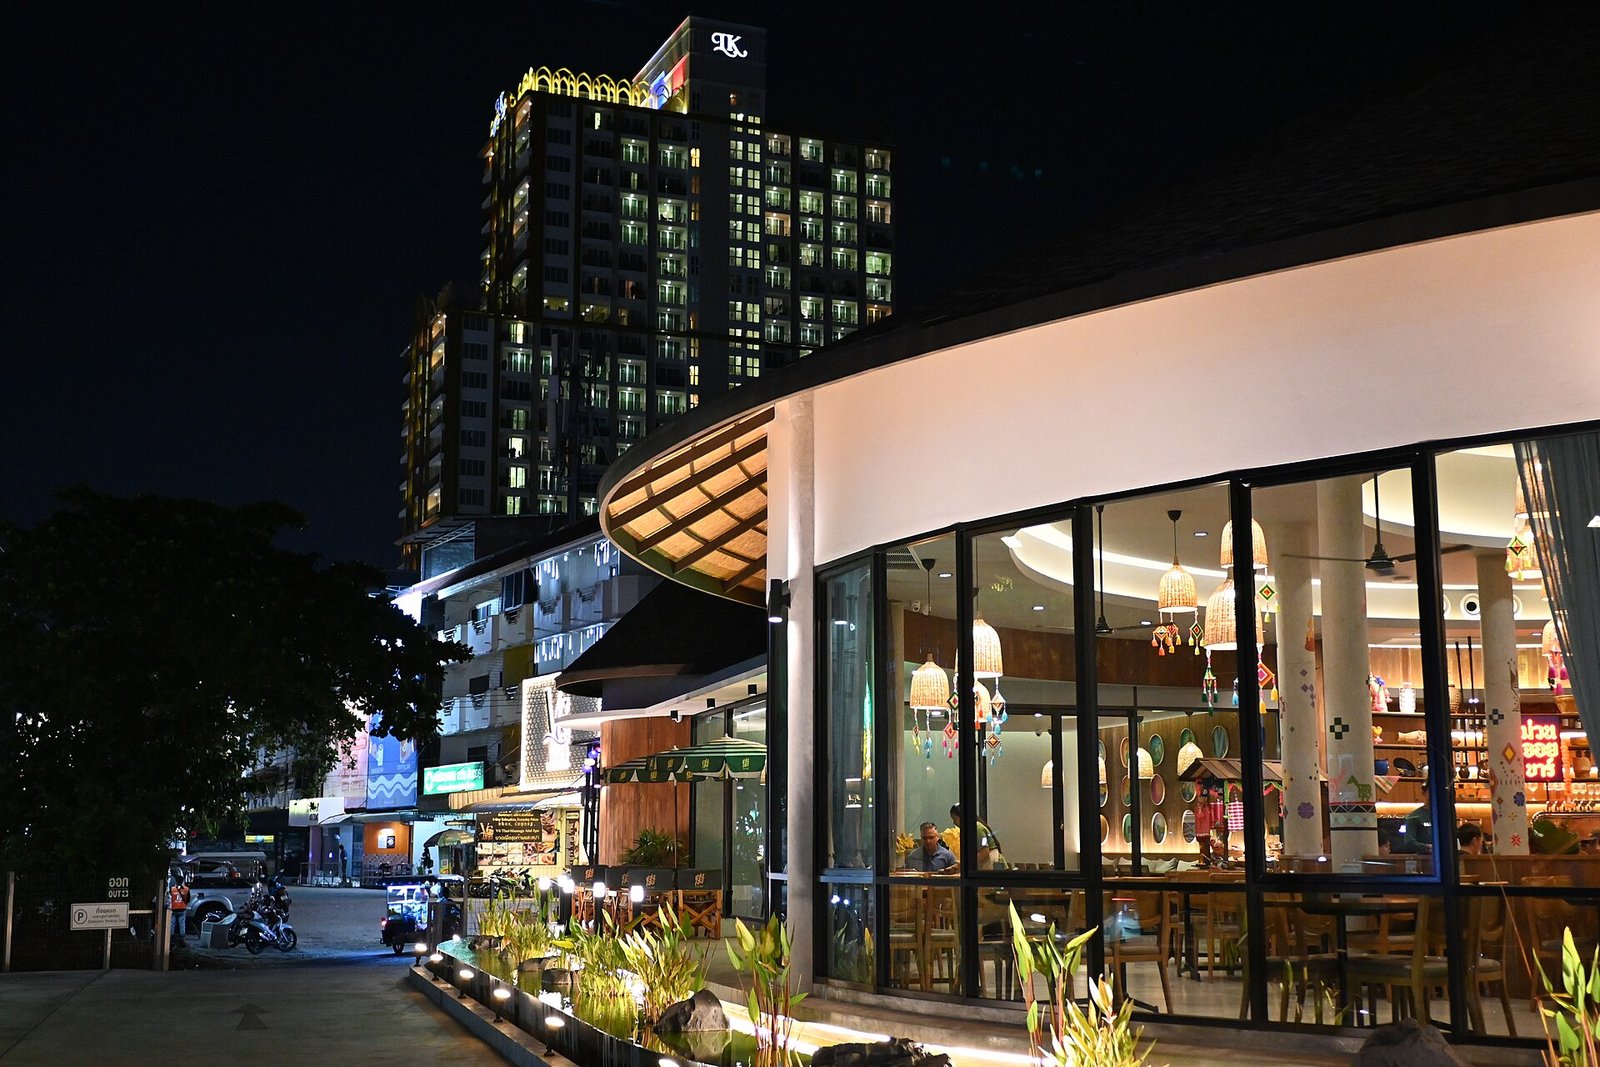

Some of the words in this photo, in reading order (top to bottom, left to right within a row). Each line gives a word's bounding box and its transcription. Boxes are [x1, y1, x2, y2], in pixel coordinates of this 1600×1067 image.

[711, 32, 748, 58] LK
[108, 877, 129, 888] ออก
[108, 890, 121, 898] OUT
[77, 911, 84, 922] P
